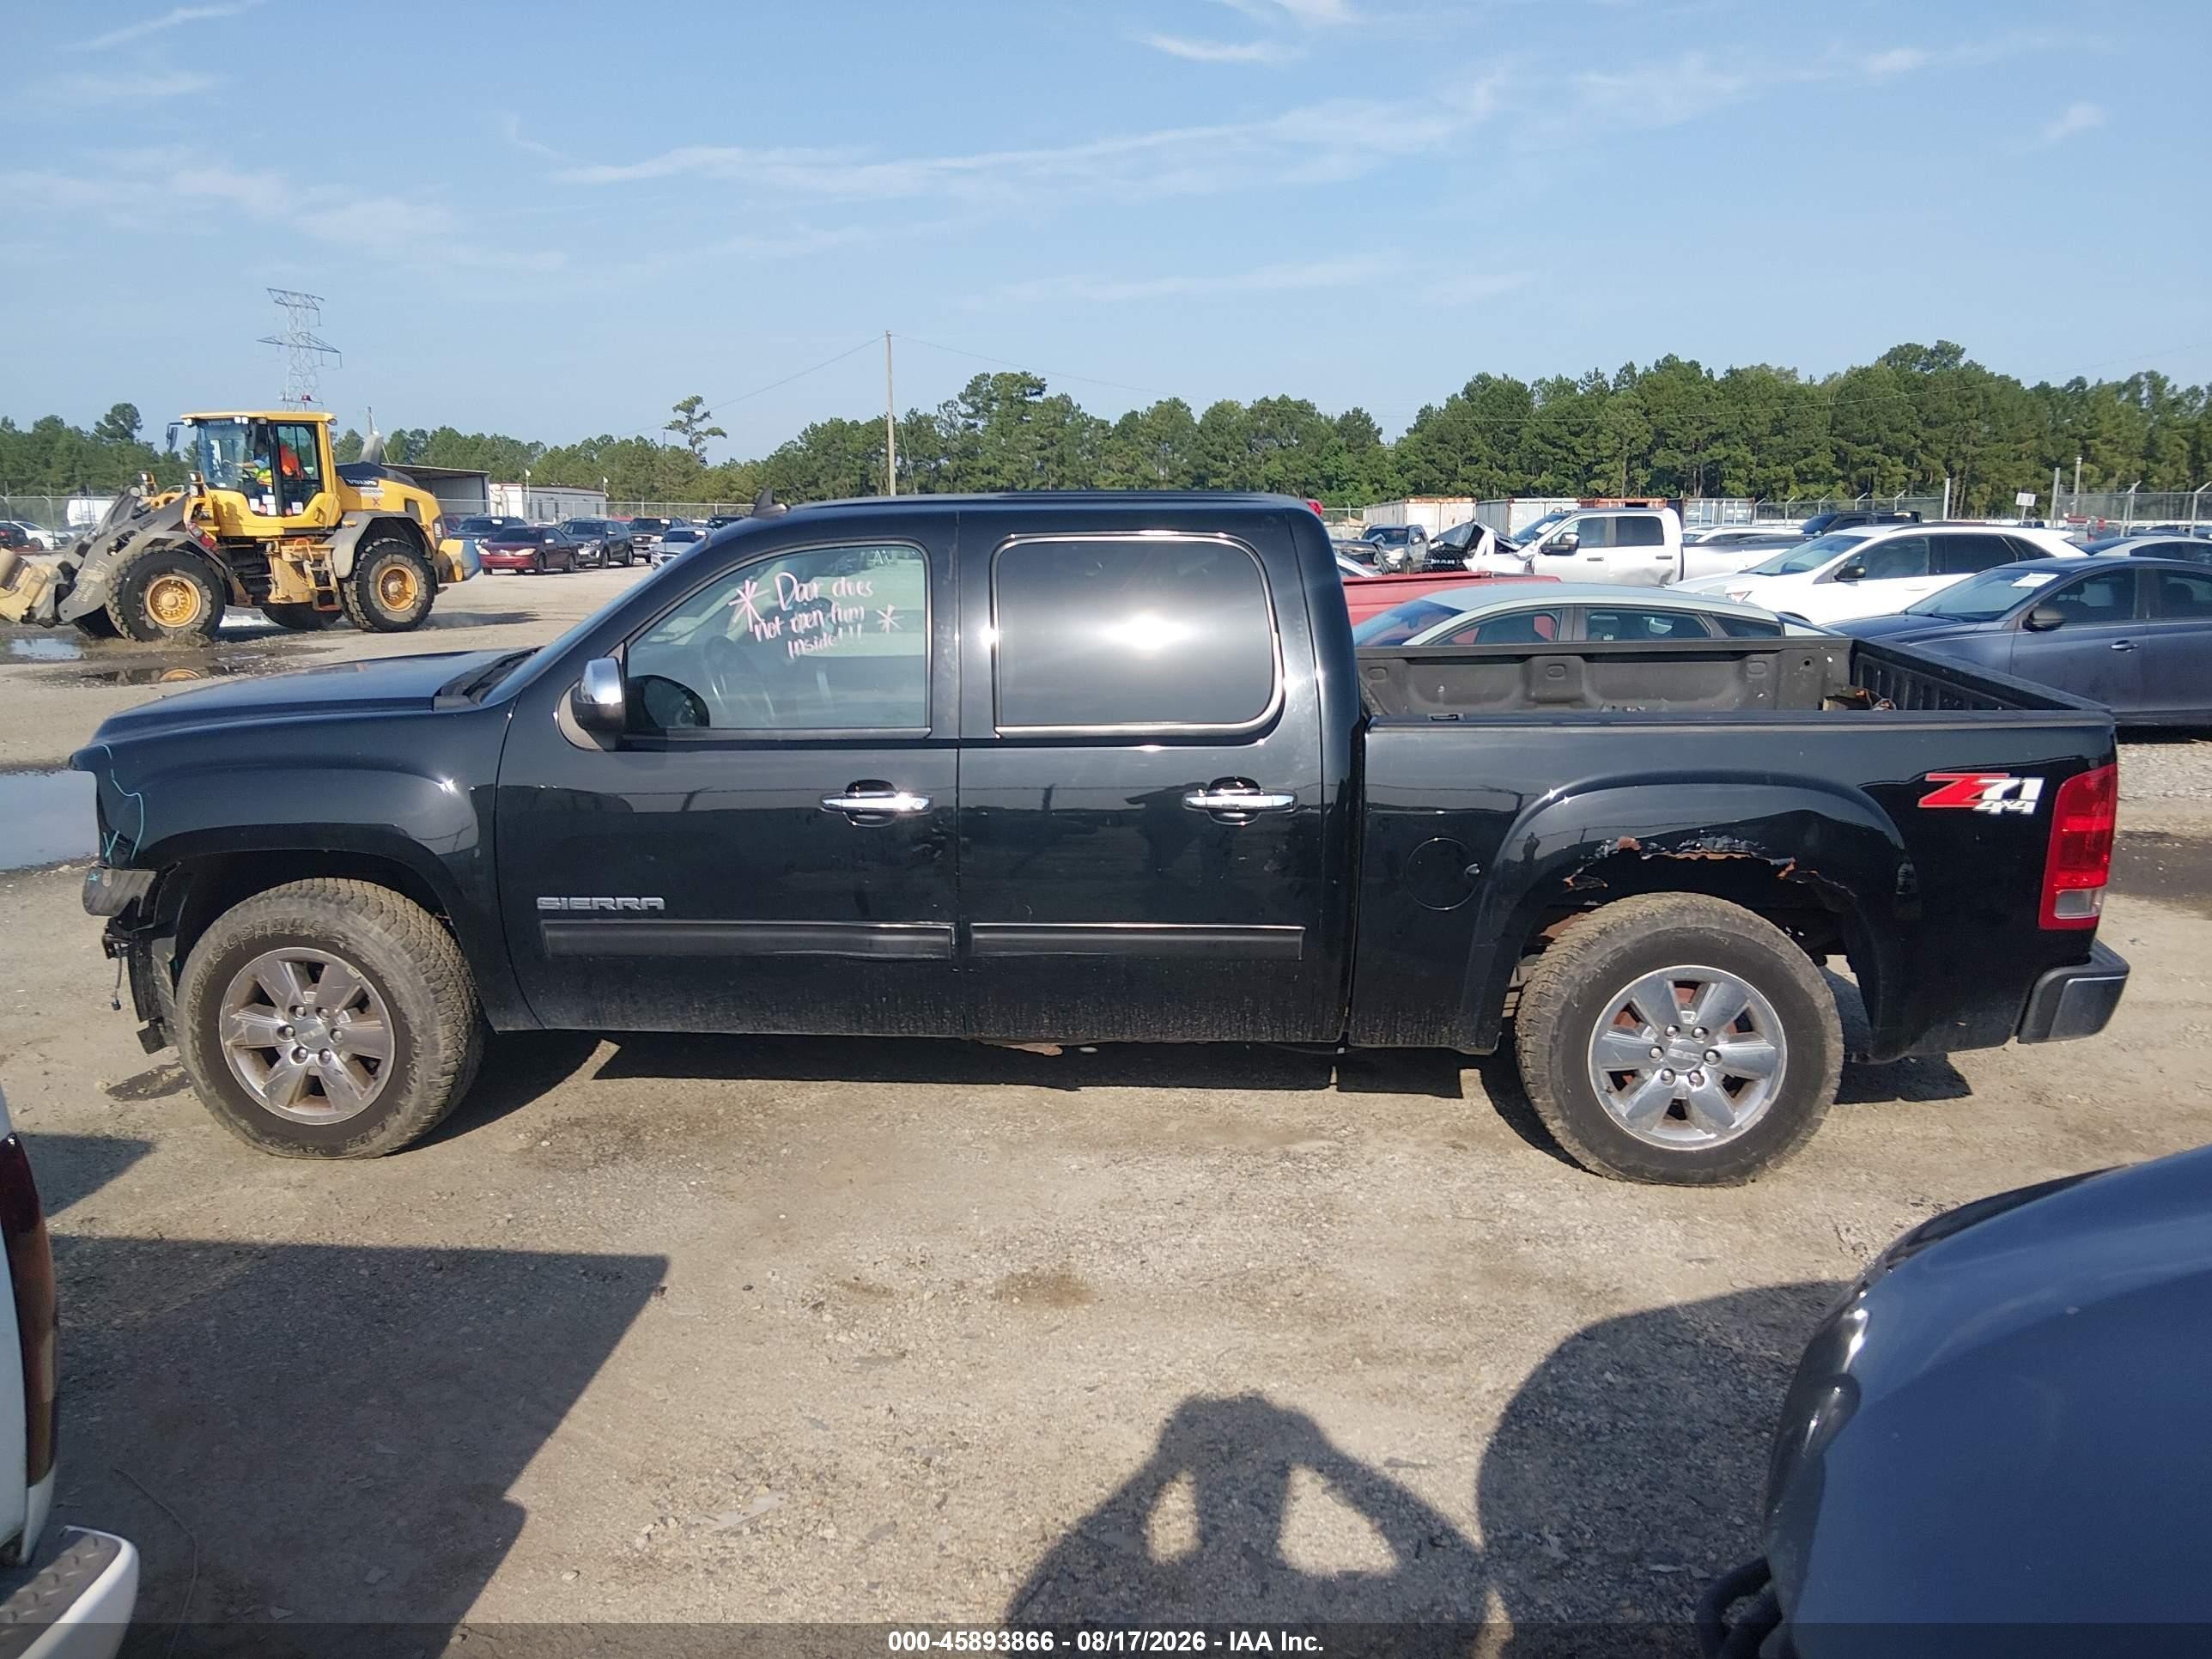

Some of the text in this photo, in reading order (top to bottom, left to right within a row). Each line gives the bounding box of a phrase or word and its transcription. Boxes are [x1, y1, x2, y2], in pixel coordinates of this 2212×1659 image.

[775, 572, 874, 611] Door does
[754, 616, 785, 642] not
[790, 609, 825, 634] open
[1917, 773, 2045, 808] Z71
[536, 896, 665, 910] SIERRA
